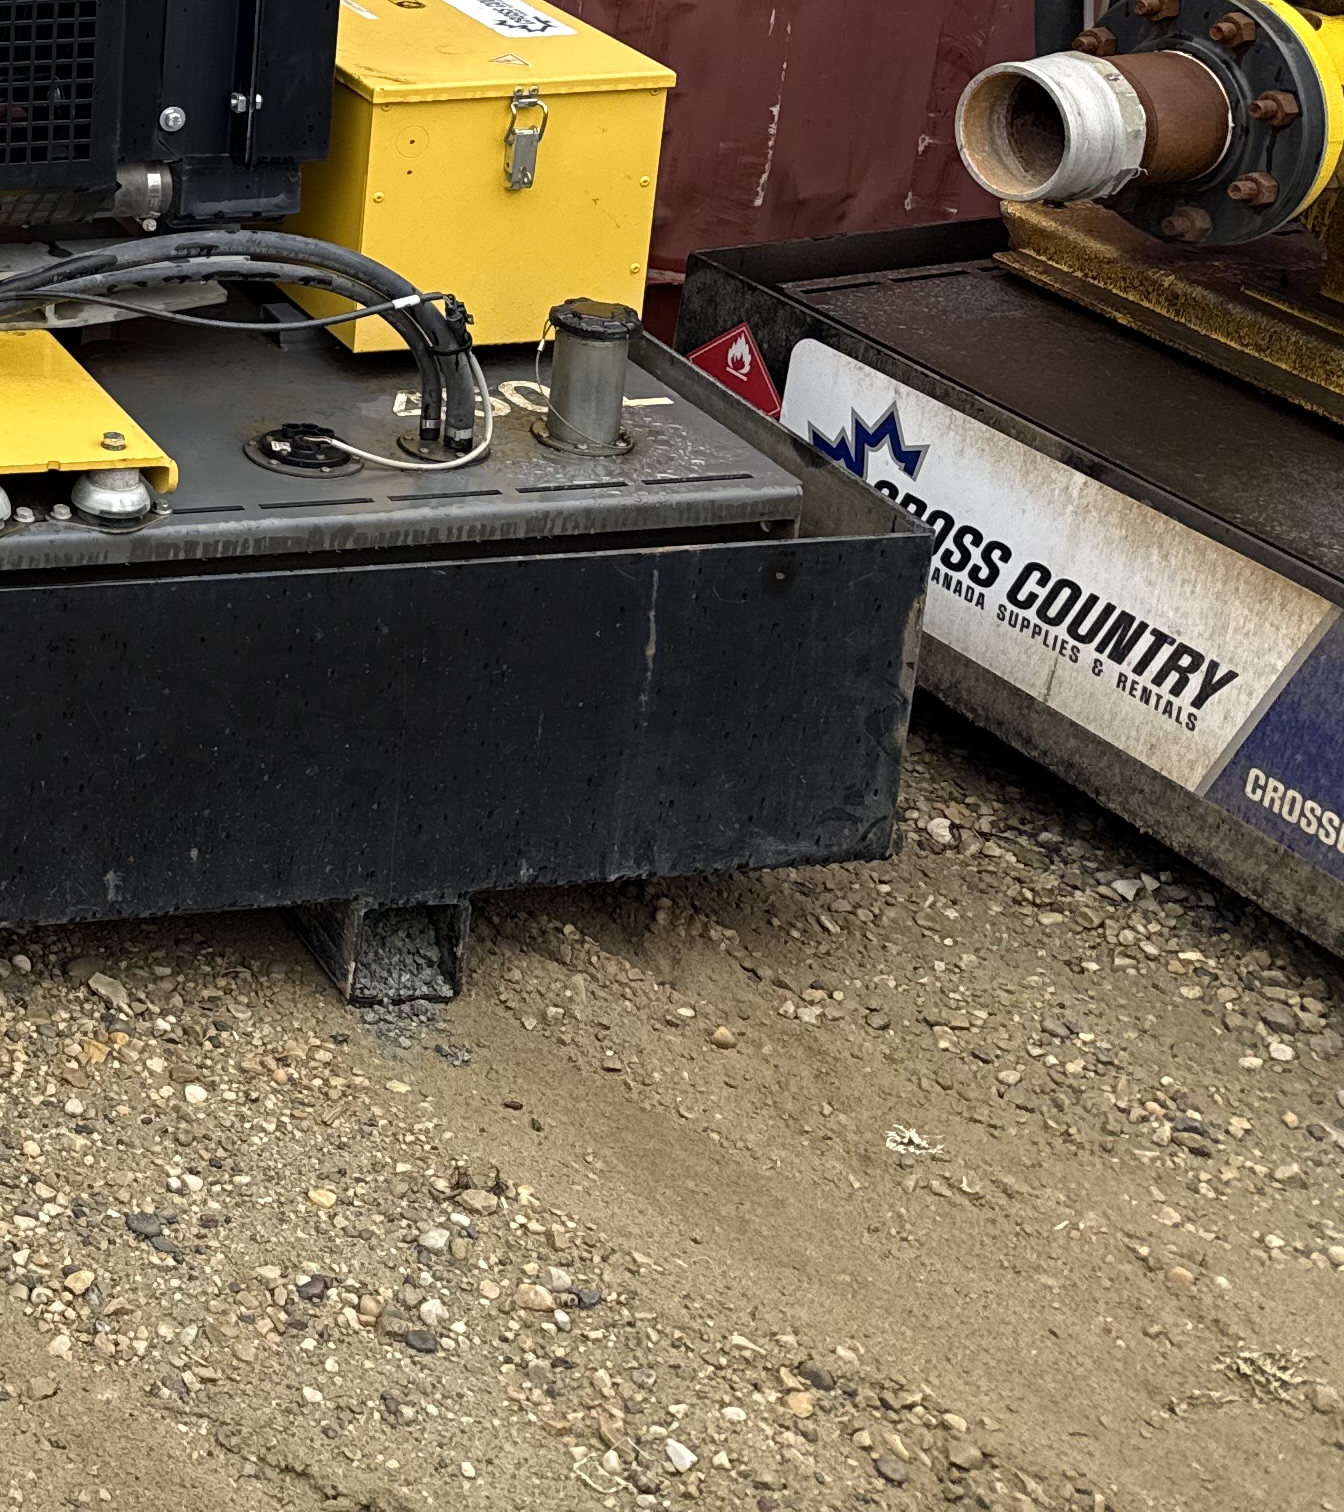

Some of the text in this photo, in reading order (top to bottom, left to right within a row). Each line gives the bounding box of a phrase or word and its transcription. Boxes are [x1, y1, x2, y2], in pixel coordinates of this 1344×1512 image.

[930, 566, 1199, 732] ANADA SUPPLIES & RENTALS
[1006, 561, 1240, 711] COUNTRY
